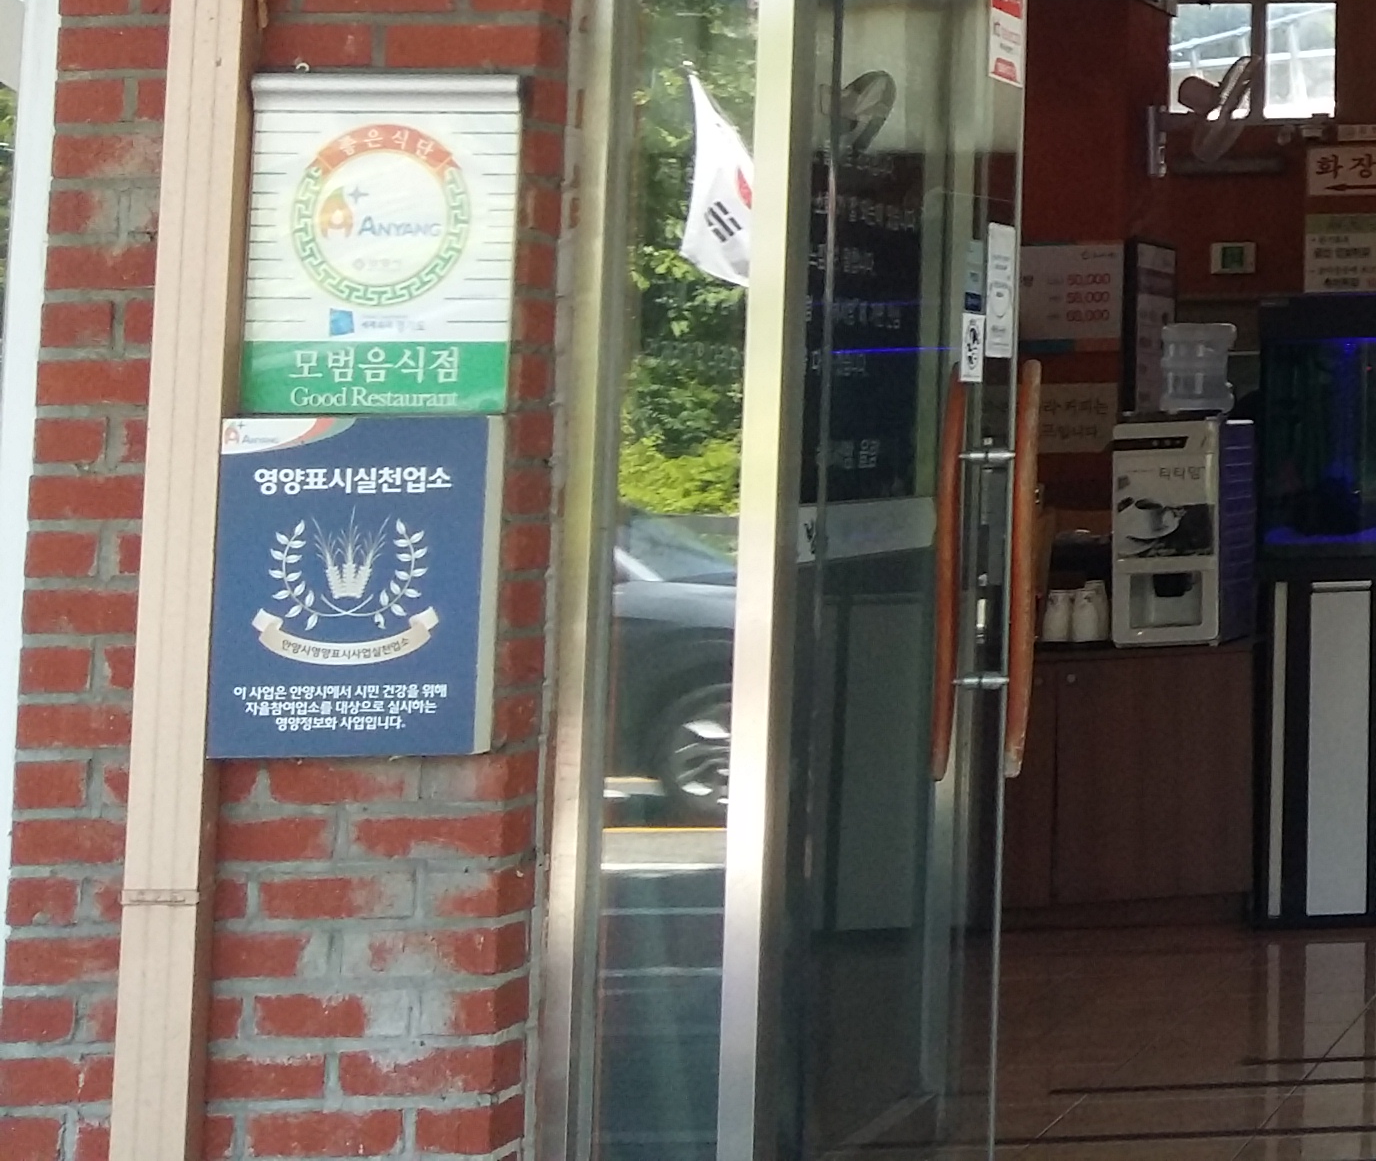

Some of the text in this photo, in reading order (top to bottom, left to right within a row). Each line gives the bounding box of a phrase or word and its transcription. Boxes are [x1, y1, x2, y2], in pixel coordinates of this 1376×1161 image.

[288, 345, 460, 384] 모범음식점
[289, 386, 459, 408] Good Restaurant
[253, 466, 453, 495] 영양표시실천업소
[233, 683, 448, 701] 이 사업은 안양시에서 시민 건강을 위해
[335, 700, 385, 715] 대상으로
[387, 699, 438, 715] 실시하는
[275, 715, 407, 732] 영양정보화 사업입니다.
